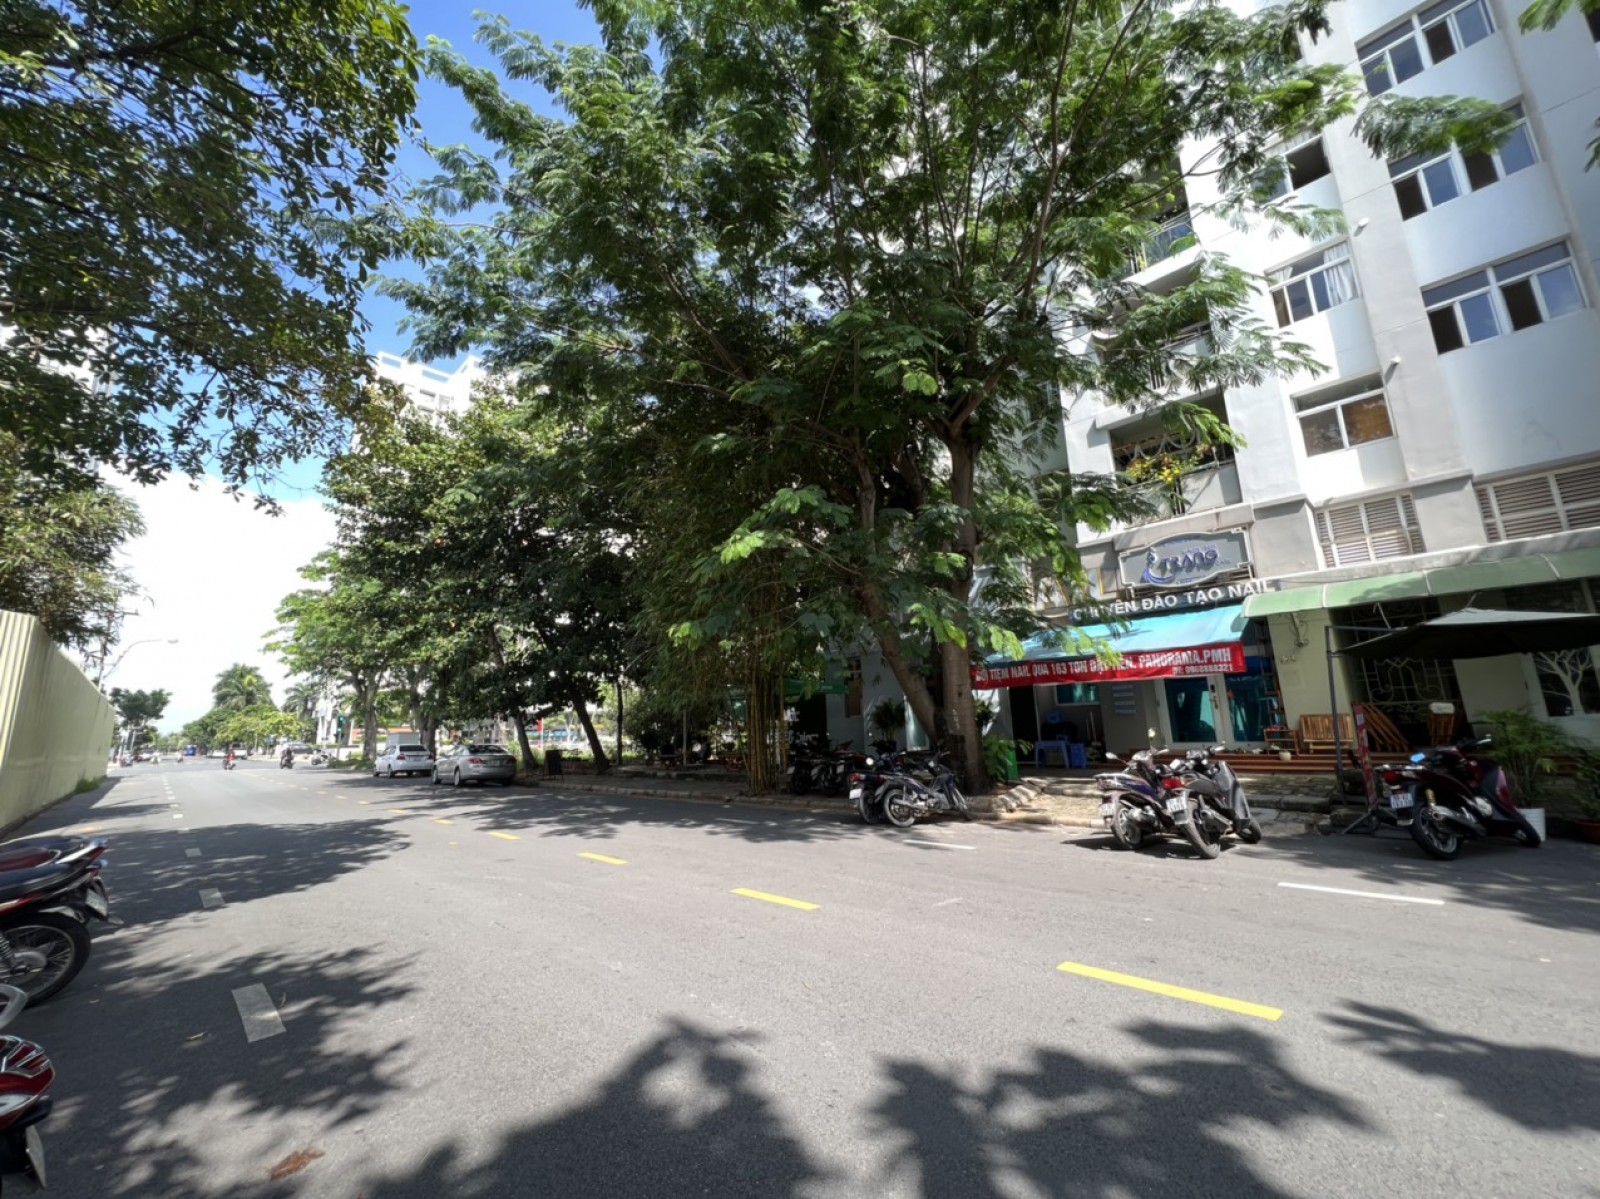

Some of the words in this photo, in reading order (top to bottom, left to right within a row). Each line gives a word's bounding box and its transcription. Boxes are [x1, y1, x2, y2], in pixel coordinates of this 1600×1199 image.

[1142, 592, 1177, 610] ĐÀO
[1184, 587, 1222, 606] TẠO
[1227, 580, 1276, 598] NAIL
[1051, 661, 1067, 676] 163
